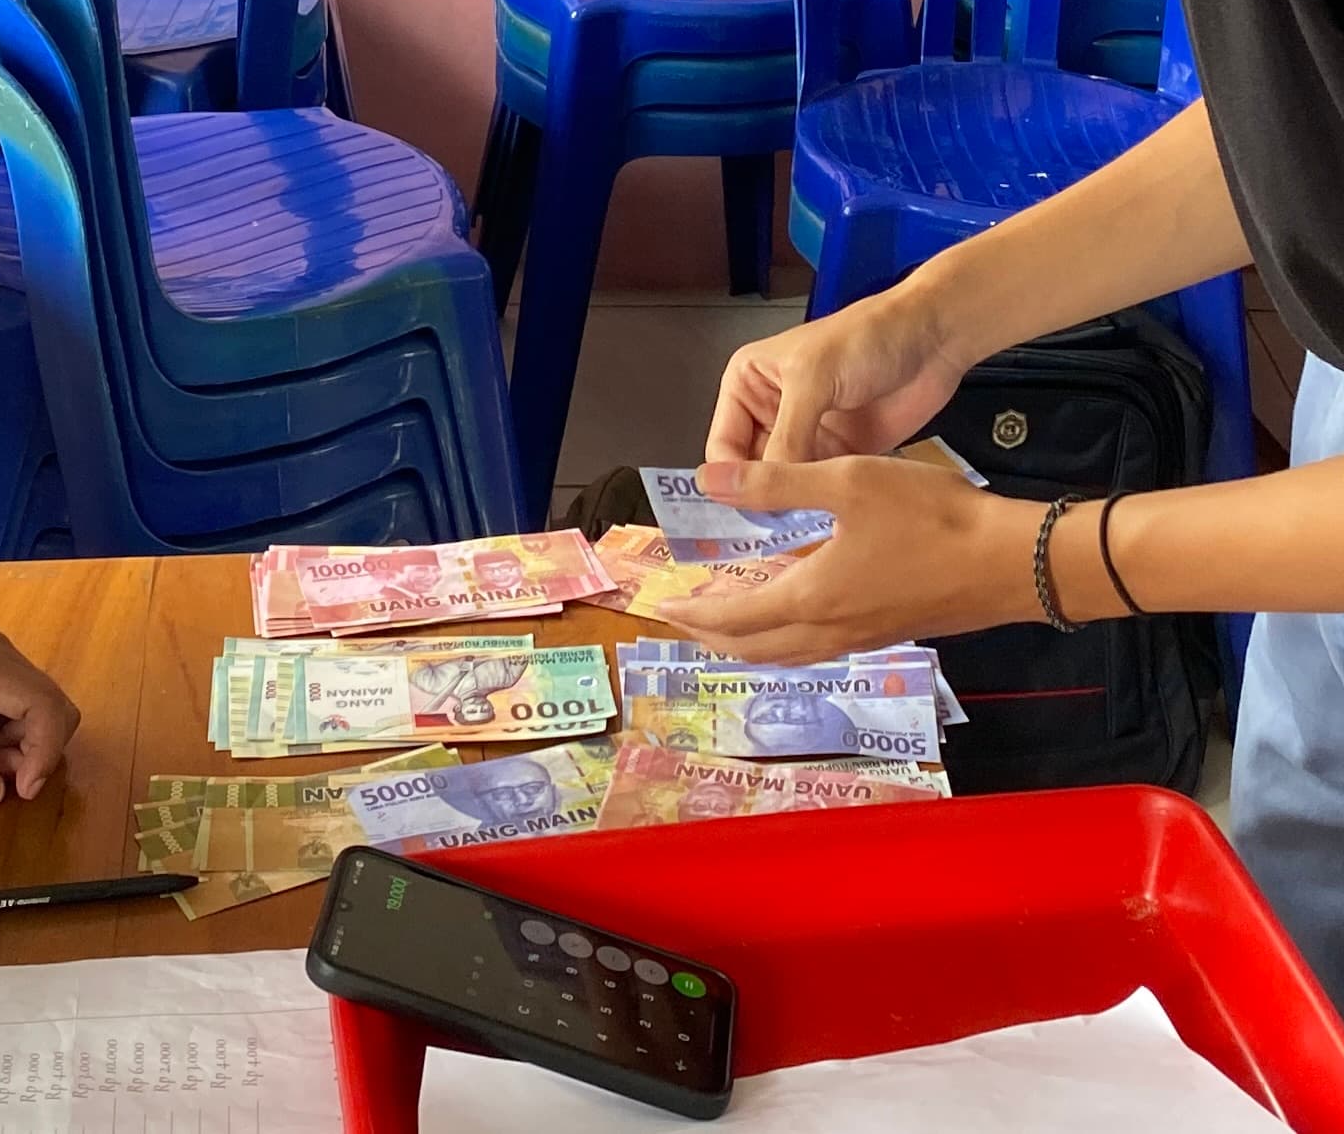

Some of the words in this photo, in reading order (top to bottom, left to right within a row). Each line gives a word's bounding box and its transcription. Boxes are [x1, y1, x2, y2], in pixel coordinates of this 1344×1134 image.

[307, 558, 390, 579] 100000
[369, 595, 442, 614] UANG
[447, 584, 549, 605] MAINAN
[326, 687, 393, 698] MAINAN
[682, 680, 787, 694] MAINAN
[797, 679, 871, 694] UANG
[336, 698, 385, 709] UANG
[510, 698, 605, 721] 1000
[842, 731, 927, 756] 50000
[675, 763, 786, 792] MAINAN
[360, 774, 448, 807] 50000
[795, 780, 872, 800] UANG
[439, 824, 519, 849] UANG
[566, 966, 578, 976] 9
[604, 979, 616, 989] 6
[561, 992, 574, 1002] 8
[642, 993, 654, 1002] 3
[600, 1005, 612, 1016] 5
[557, 1018, 569, 1029] 7
[639, 1018, 652, 1029] 2
[597, 1032, 608, 1042] 4
[678, 1032, 690, 1042] 0
[128, 1041, 145, 1075] 6.000
[98, 1077, 122, 1093] Rp
[126, 1077, 150, 1094] Rp
[153, 1076, 176, 1093] Rp
[181, 1074, 204, 1091] Rp
[210, 1072, 233, 1089] Rp
[241, 1069, 265, 1087] Rp
[19, 1085, 44, 1103] Rp
[45, 1083, 68, 1101] Rp
[72, 1082, 95, 1099] Rp
